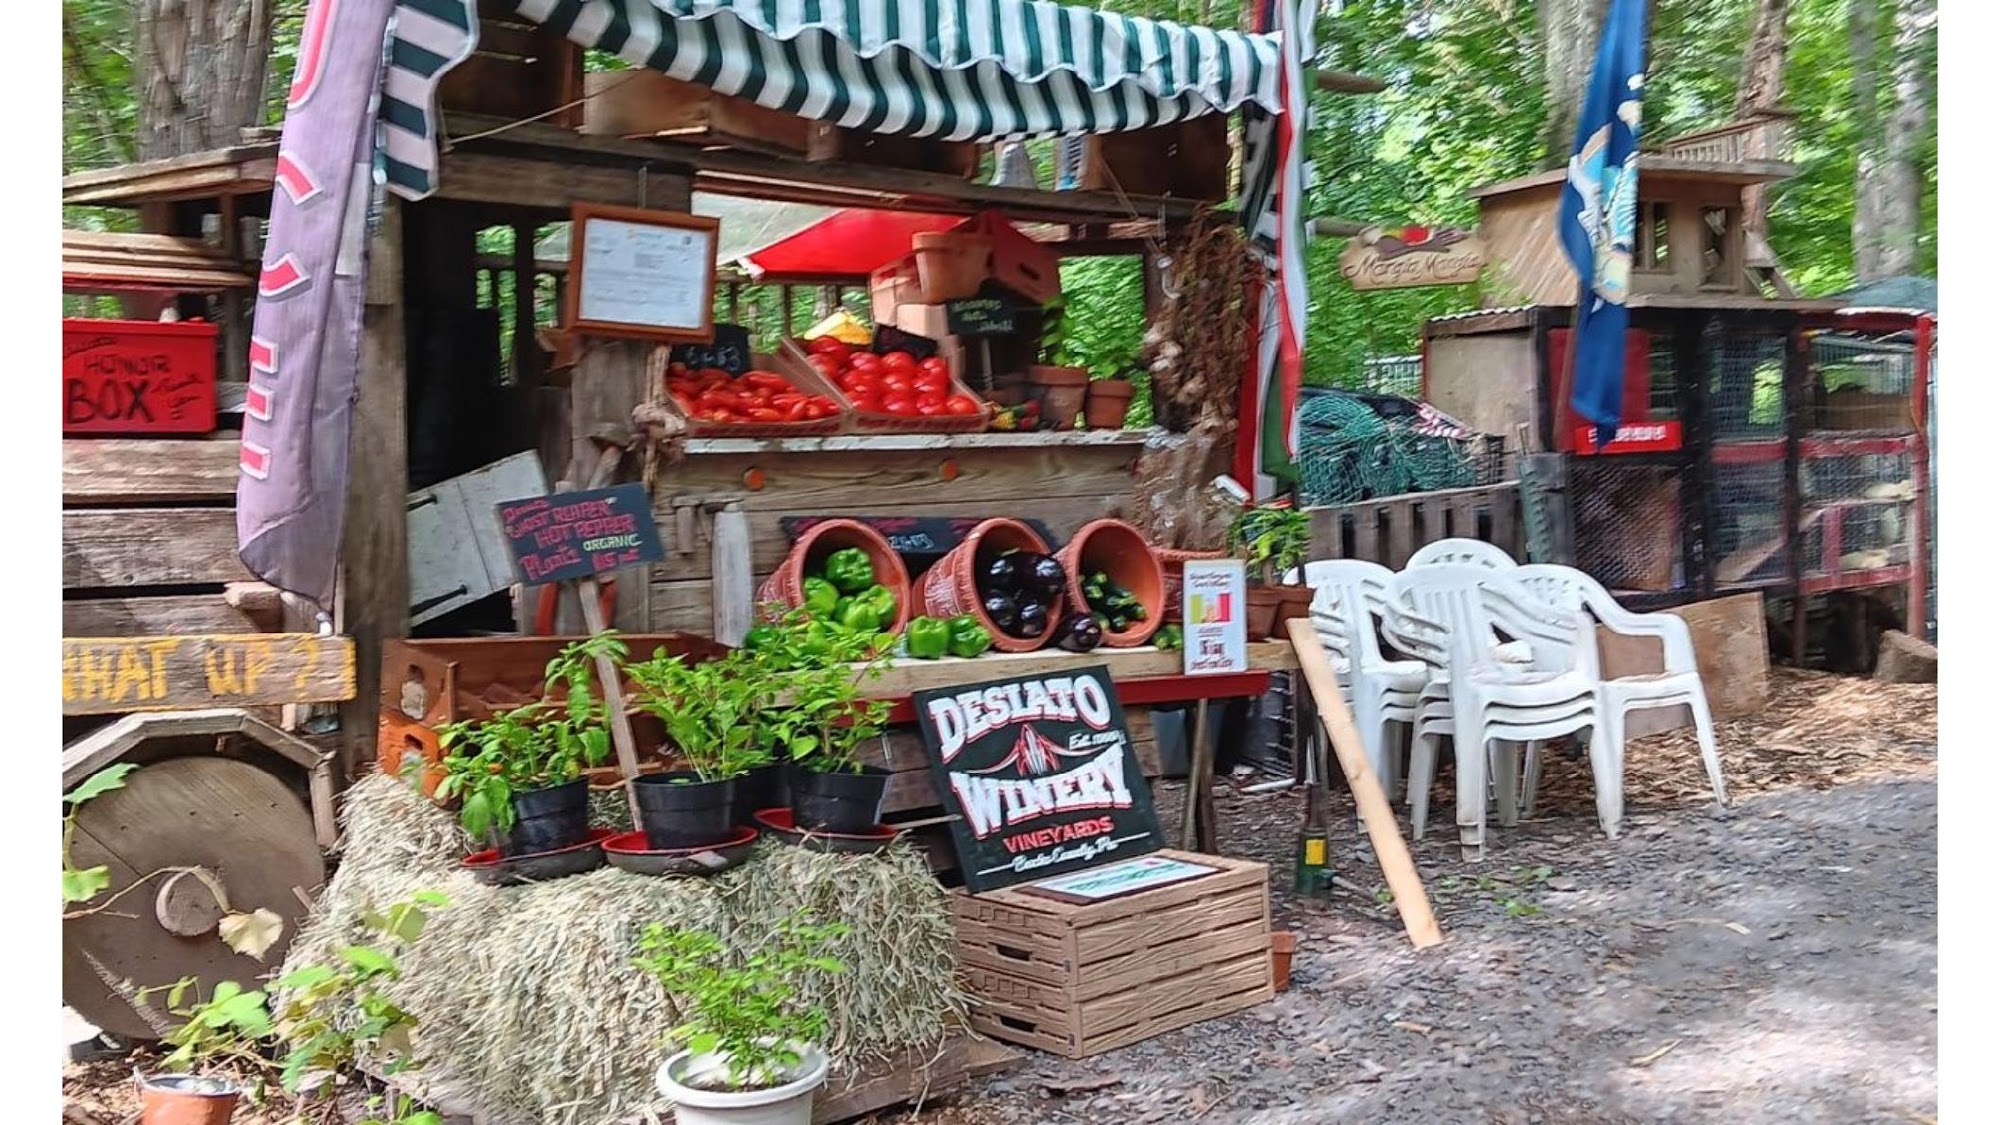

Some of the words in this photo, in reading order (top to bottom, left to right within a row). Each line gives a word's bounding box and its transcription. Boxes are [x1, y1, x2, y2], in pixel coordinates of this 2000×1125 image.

[66, 377, 155, 425] BOX
[535, 522, 572, 549] HOT
[582, 533, 643, 551] ORGANIC
[949, 740, 1133, 841] WINERY
[1003, 816, 1115, 854] VINEYARDS
